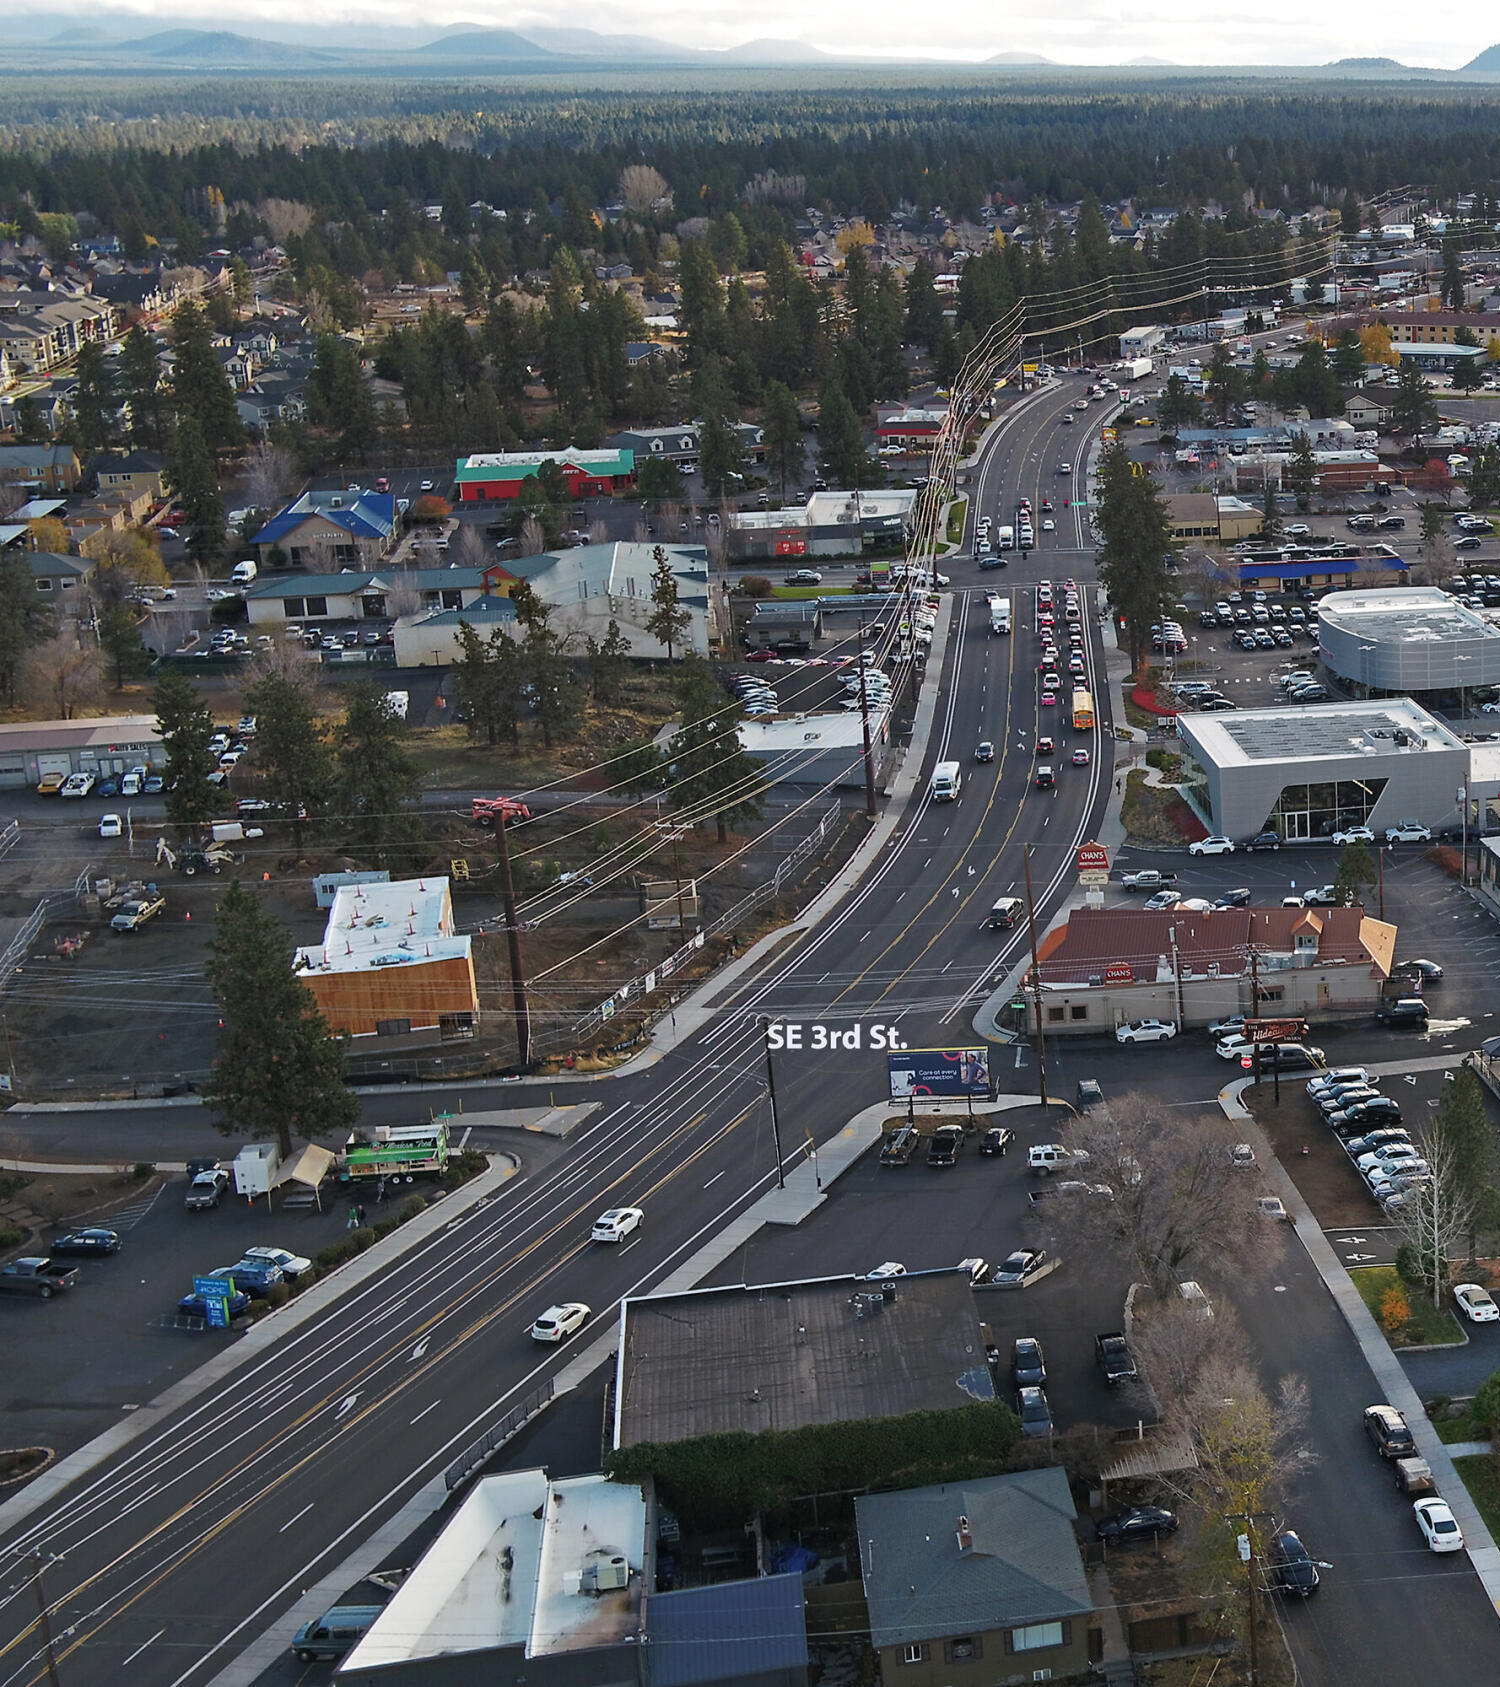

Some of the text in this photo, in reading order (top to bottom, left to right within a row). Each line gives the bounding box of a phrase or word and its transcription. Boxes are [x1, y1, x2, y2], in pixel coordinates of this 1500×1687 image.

[1081, 851, 1104, 860] CHAN'S
[1107, 969, 1131, 977] CHAN'S
[416, 1137, 434, 1147] Food
